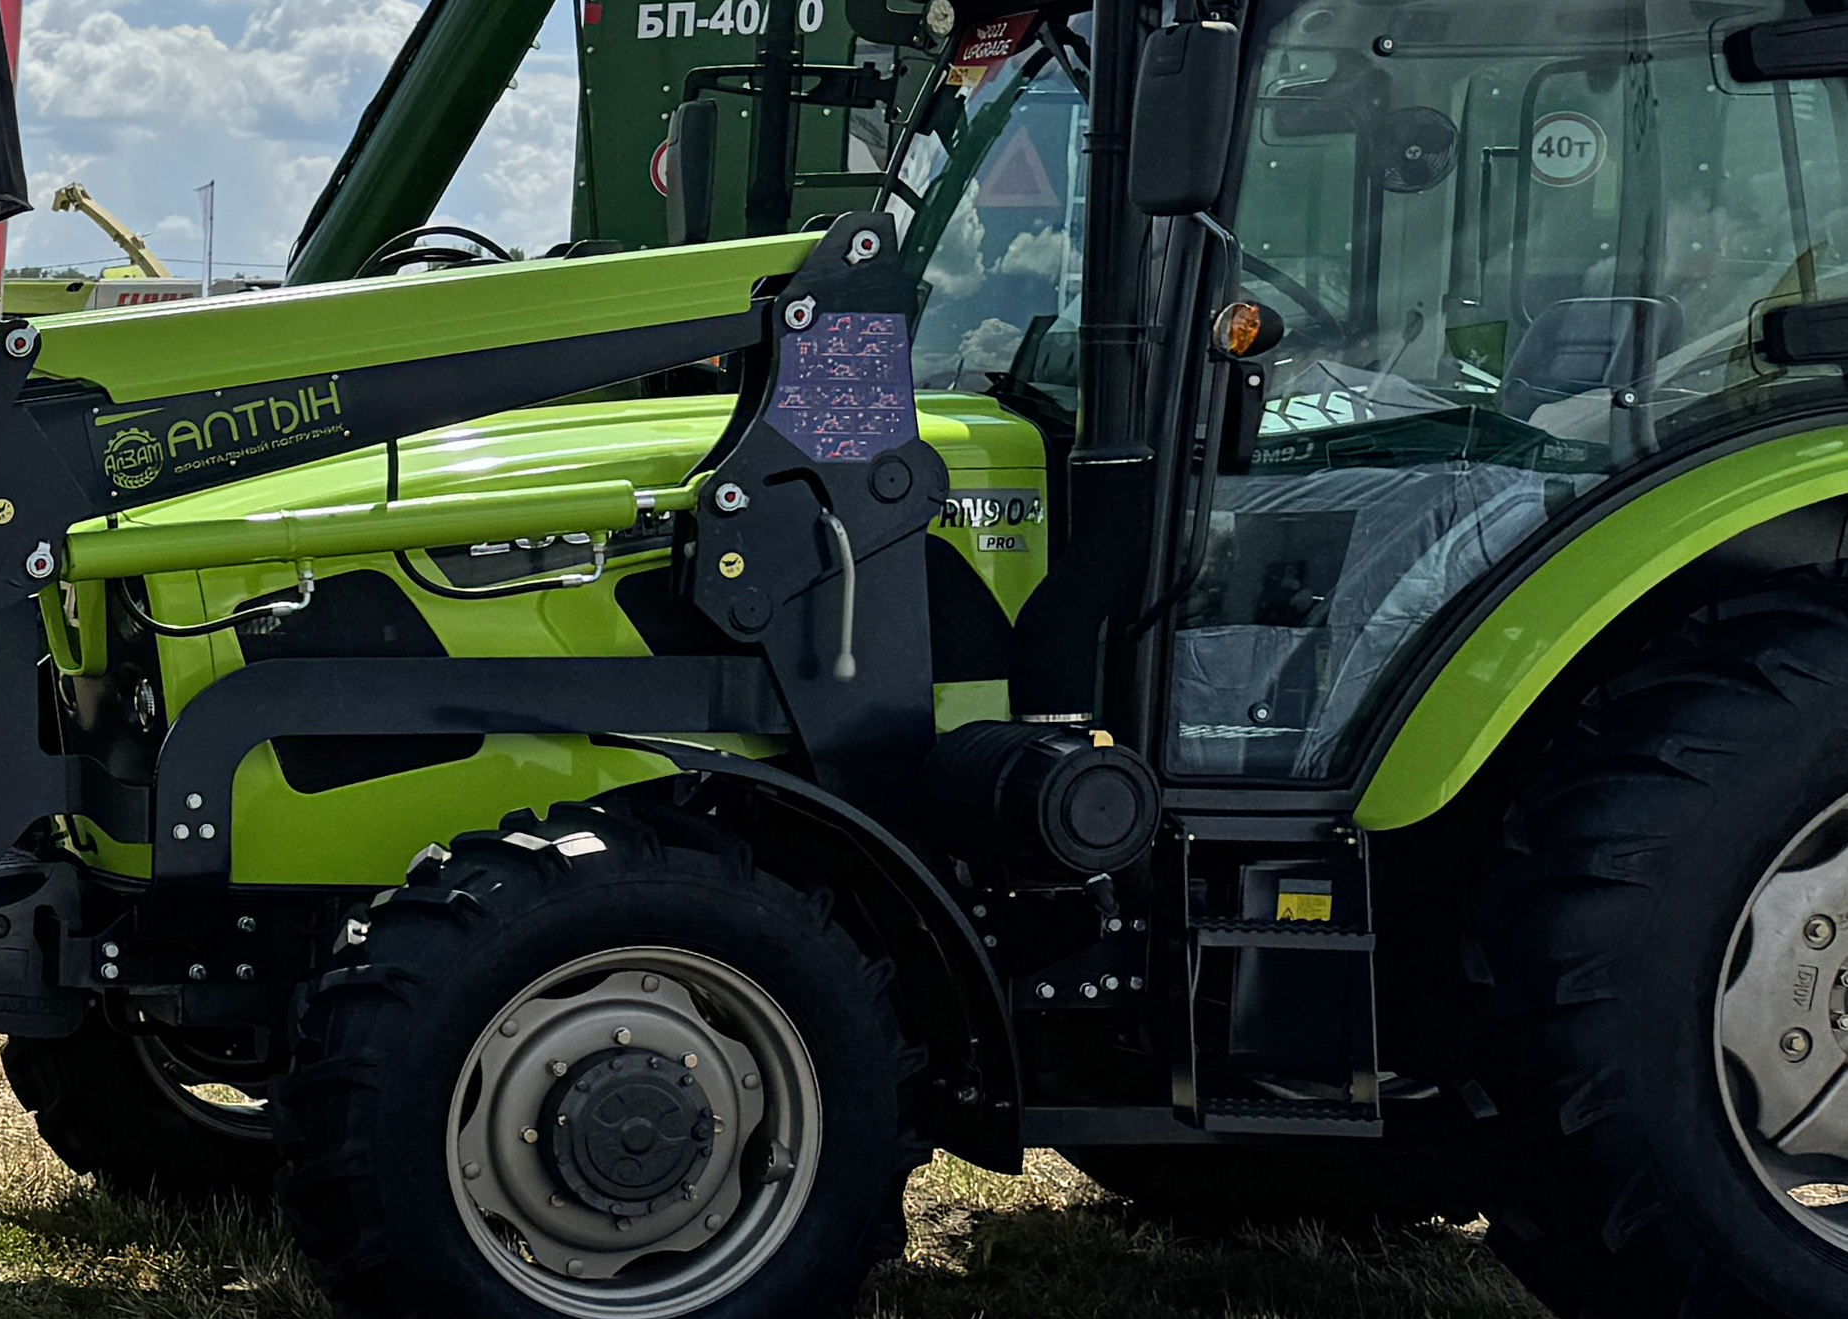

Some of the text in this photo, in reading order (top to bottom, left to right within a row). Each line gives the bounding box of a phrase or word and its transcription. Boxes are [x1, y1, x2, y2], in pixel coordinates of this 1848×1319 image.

[173, 423, 345, 474] ФРОНТАЛЬНЫЙ ПОГРУЗЧИК
[940, 497, 1045, 528] RN904
[986, 537, 1016, 550] PRO
